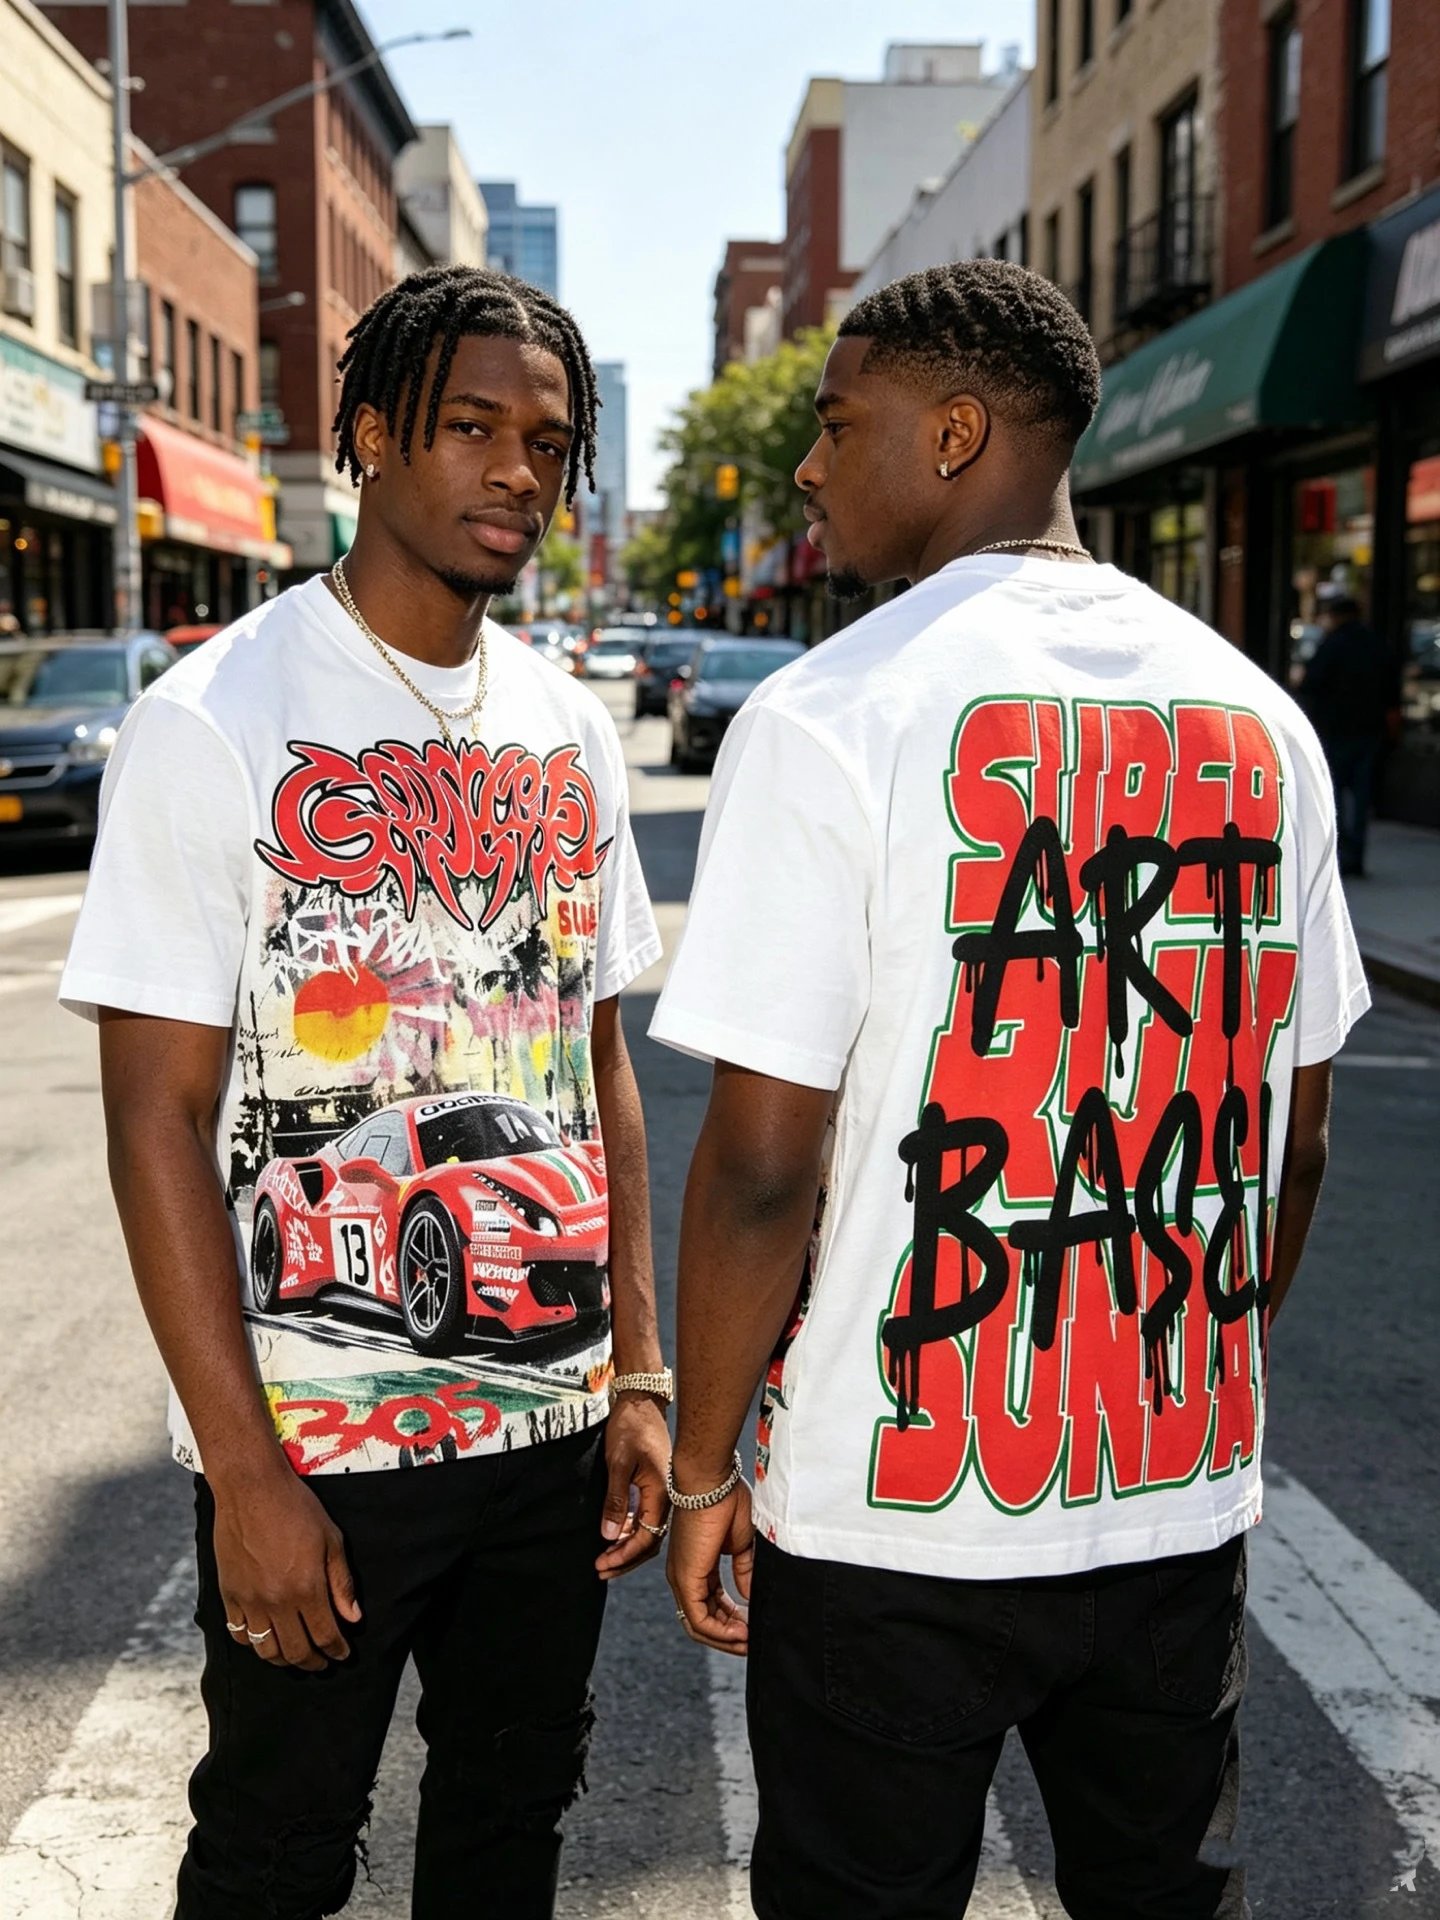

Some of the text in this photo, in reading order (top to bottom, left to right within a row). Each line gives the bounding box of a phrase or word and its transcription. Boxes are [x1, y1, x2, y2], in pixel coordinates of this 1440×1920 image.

[943, 693, 1284, 933] SUPER
[952, 815, 1281, 1060] ART
[340, 1223, 369, 1287] 13
[867, 1214, 1276, 1516] SUNDA
[276, 1379, 502, 1476] 305
